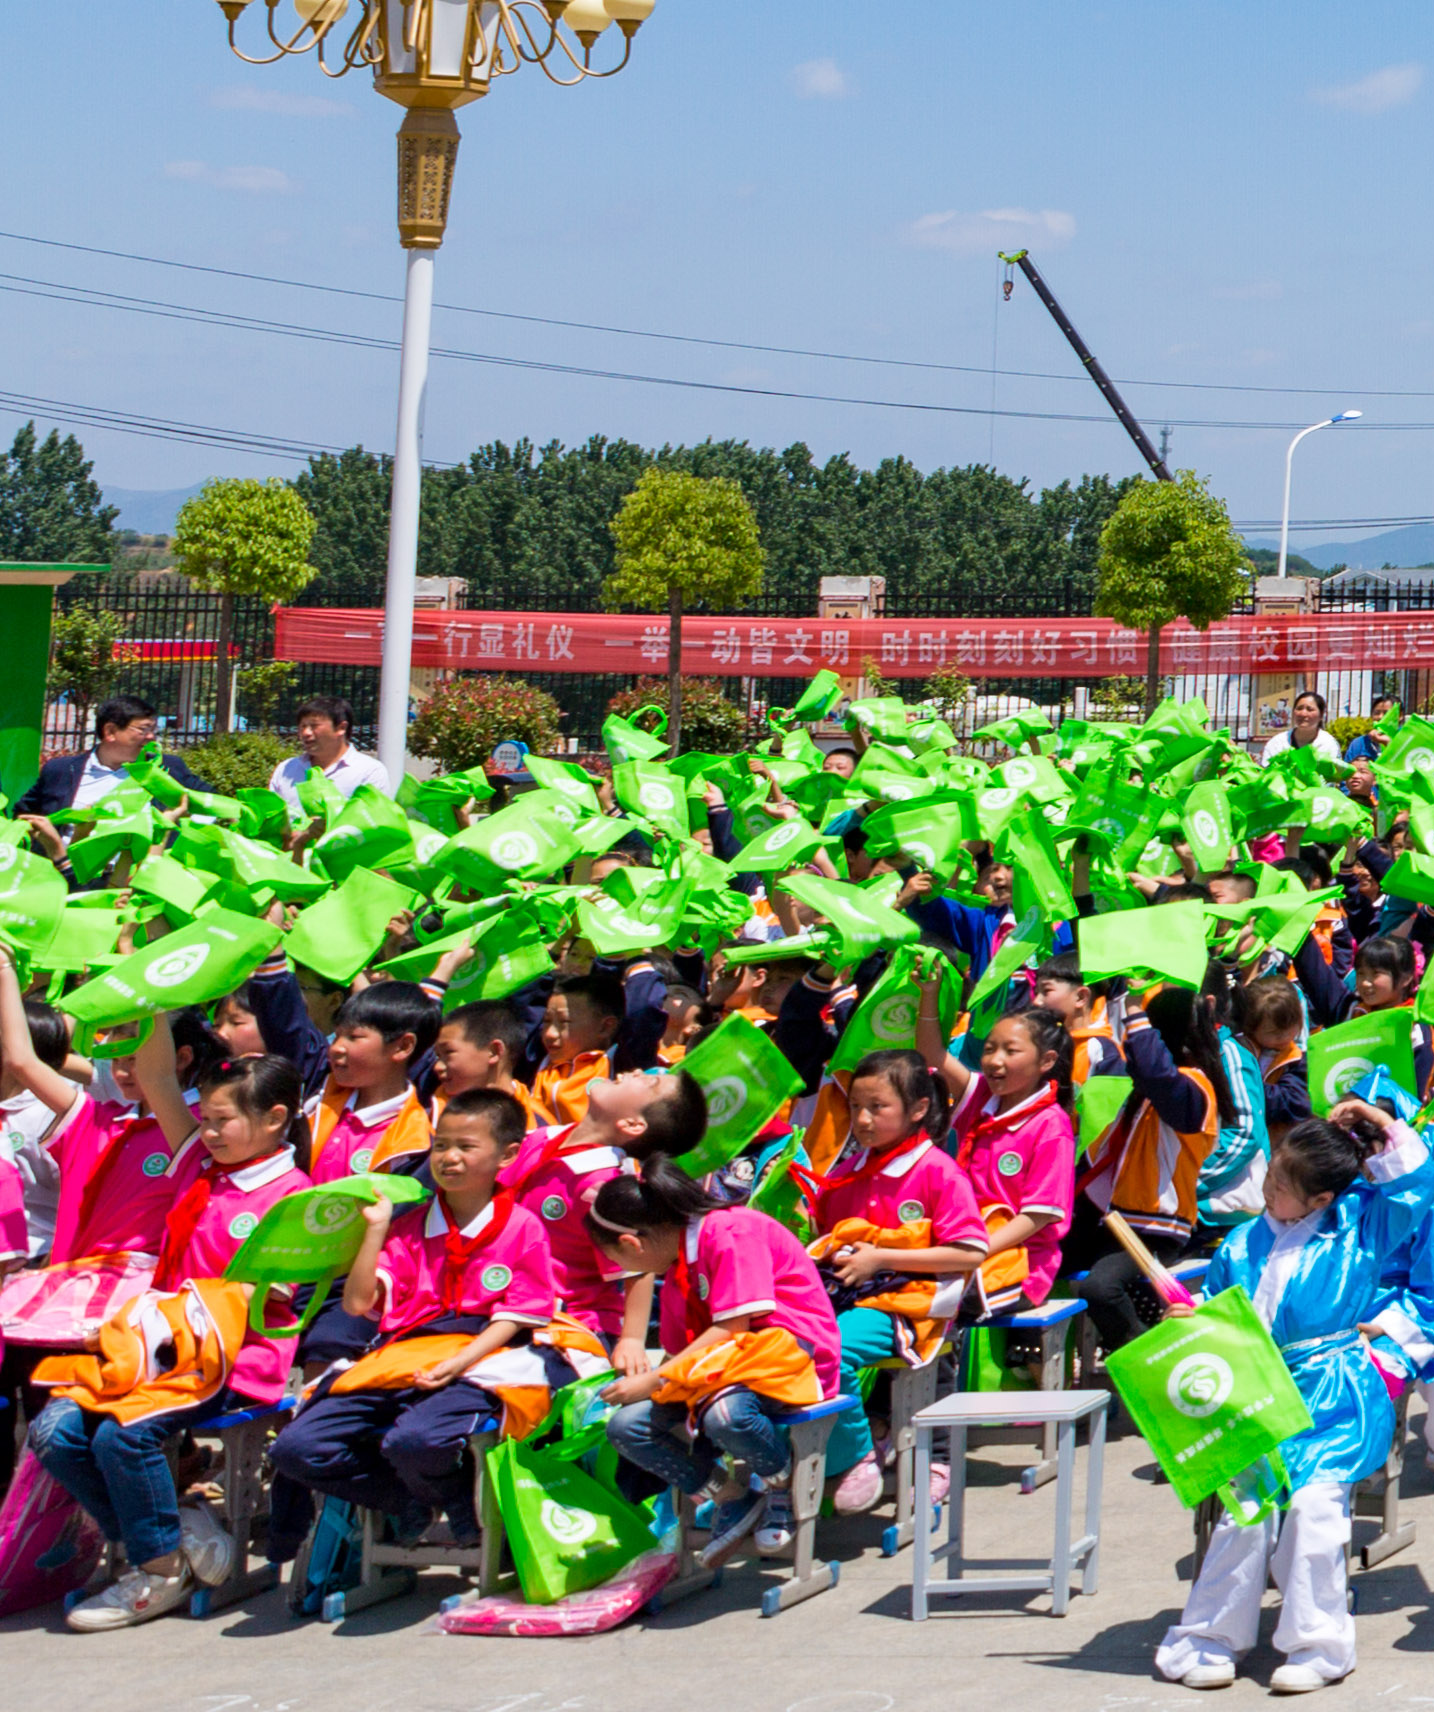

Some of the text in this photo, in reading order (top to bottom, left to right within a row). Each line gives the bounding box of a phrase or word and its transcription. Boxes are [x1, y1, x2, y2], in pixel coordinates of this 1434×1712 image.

[344, 620, 575, 661] 一一行显礼仪
[604, 625, 850, 666] 一举一动皆文明
[881, 628, 1139, 667] 时时刻刻好习惯
